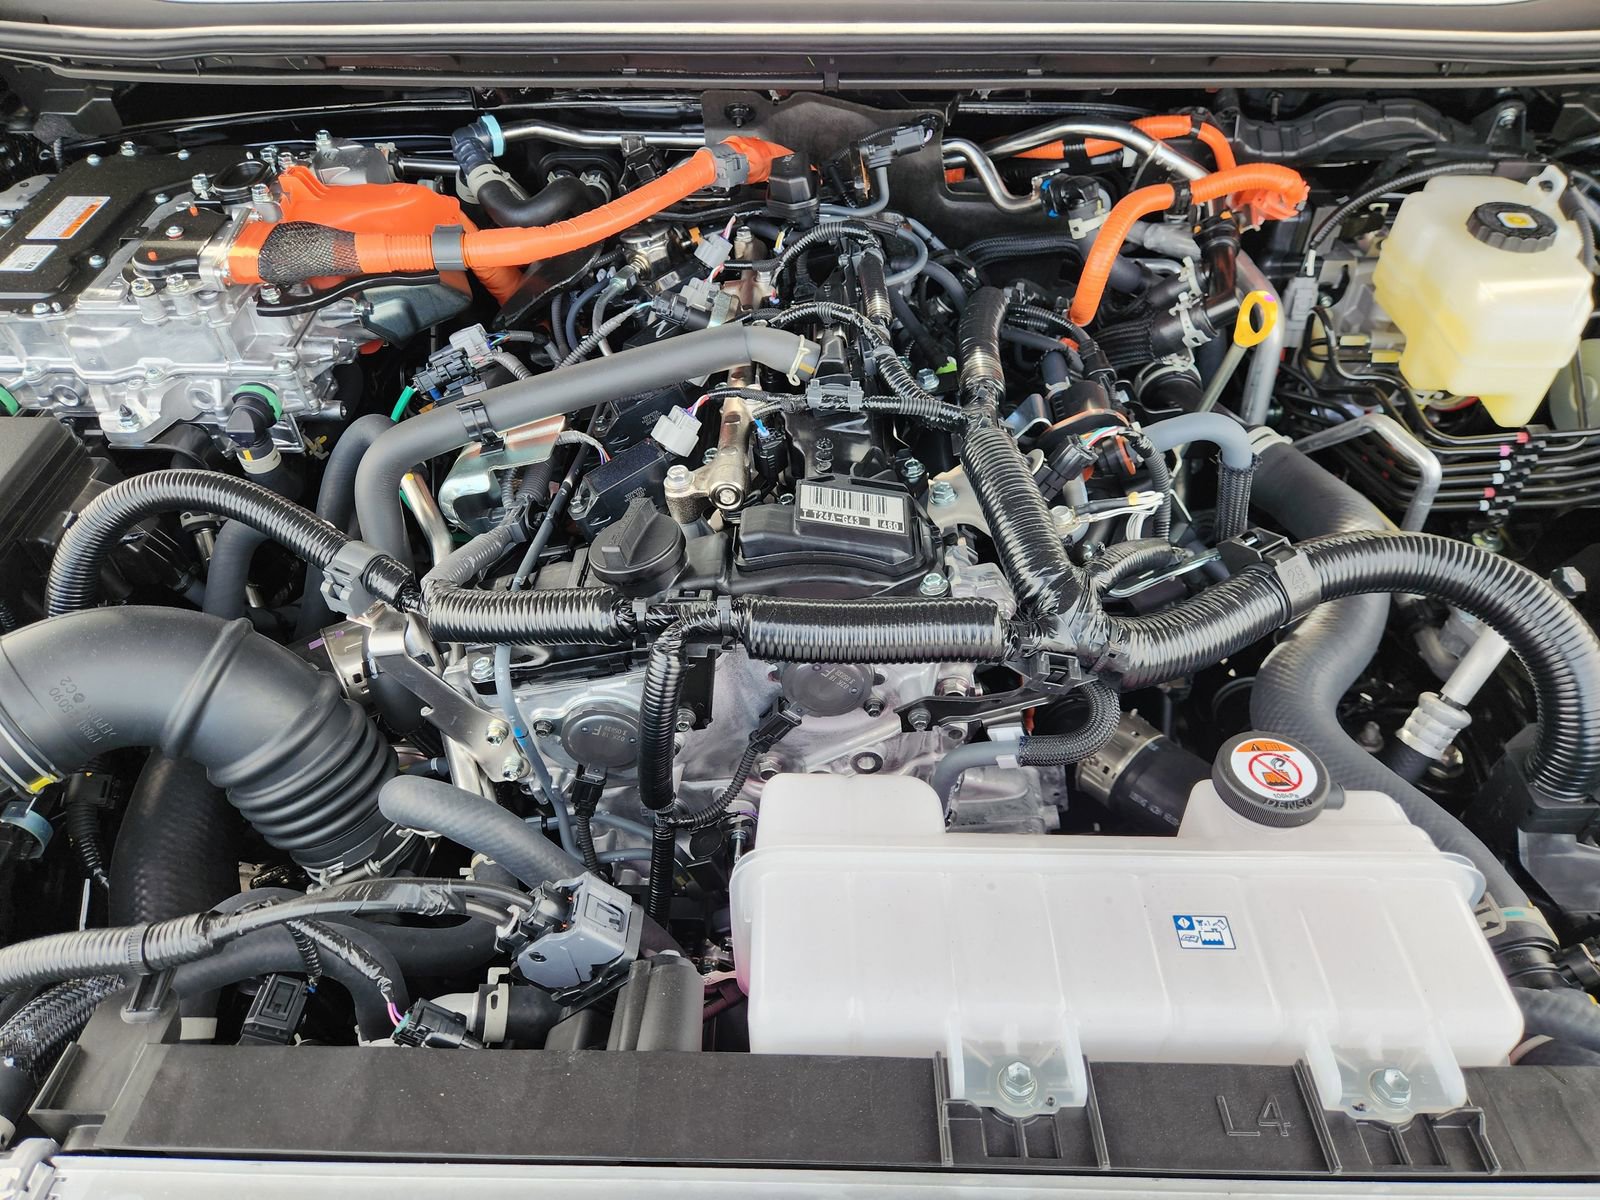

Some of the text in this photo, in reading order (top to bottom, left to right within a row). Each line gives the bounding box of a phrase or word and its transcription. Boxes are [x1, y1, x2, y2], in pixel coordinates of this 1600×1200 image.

[812, 511, 860, 525] T24A-G43
[48, 687, 103, 744] 178815090
[1264, 798, 1314, 810] DENSO
[1215, 1095, 1291, 1137] L4
